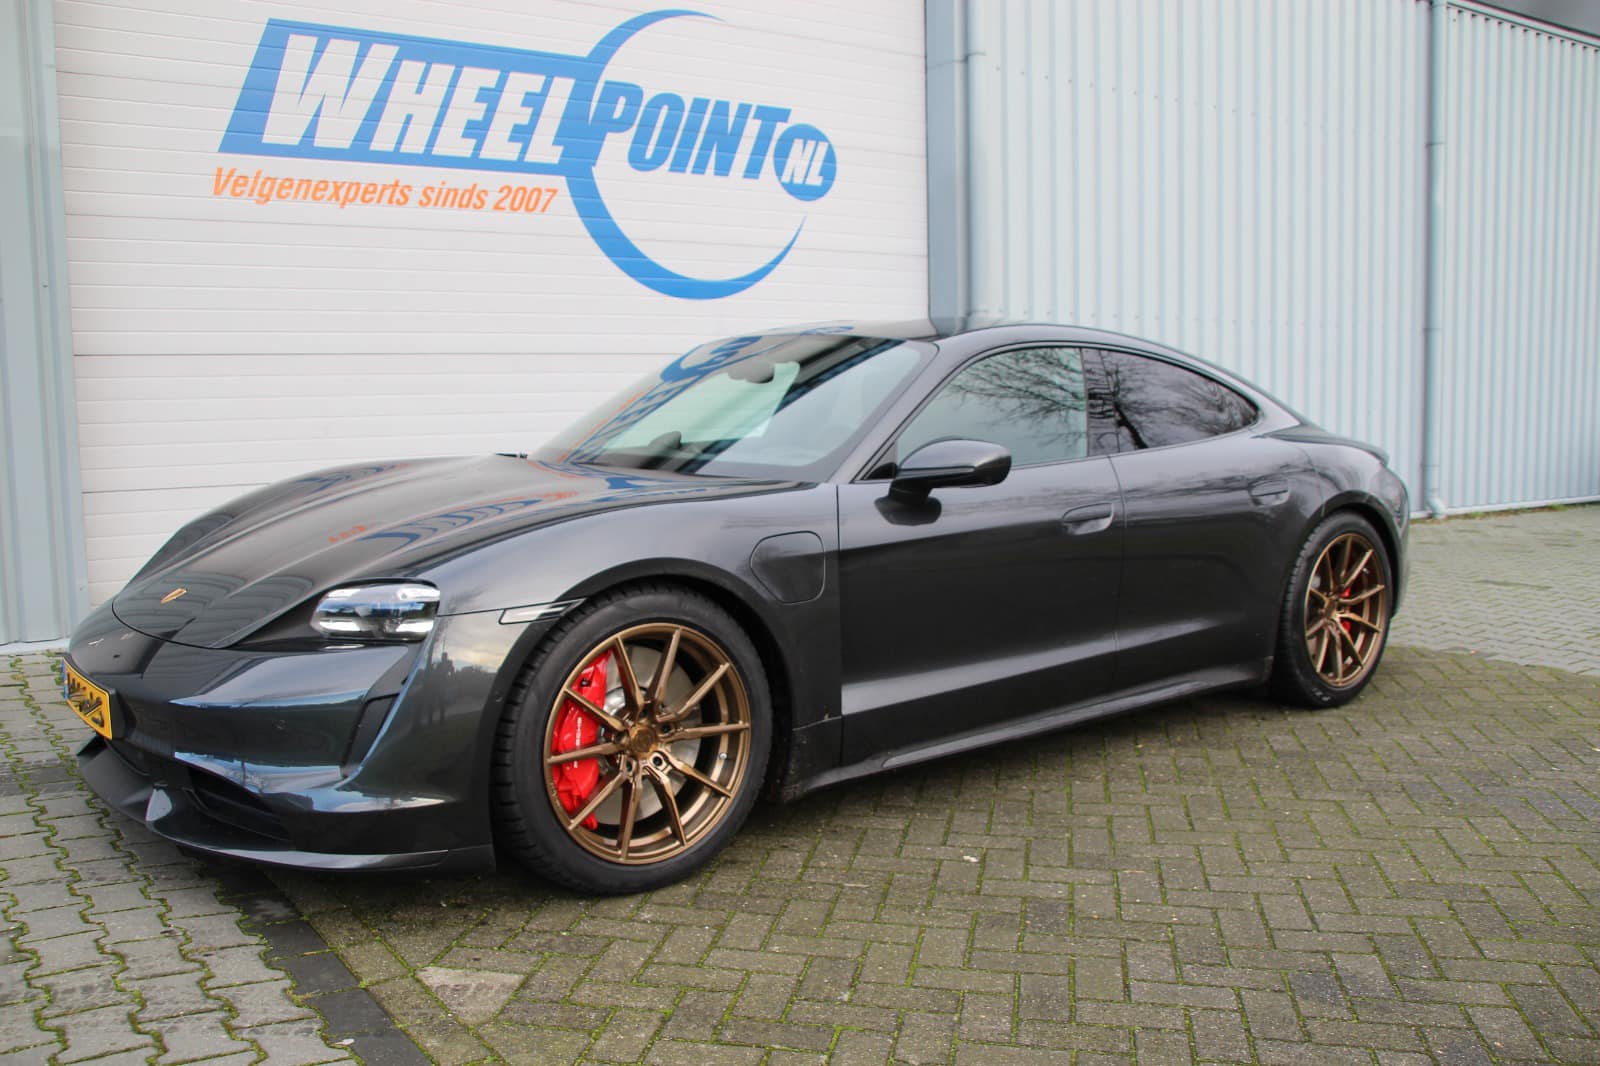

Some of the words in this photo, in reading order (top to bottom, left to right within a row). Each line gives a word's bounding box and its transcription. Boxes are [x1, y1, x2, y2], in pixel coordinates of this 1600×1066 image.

[781, 138, 829, 187] NL
[212, 167, 411, 208] Velgenexperts
[419, 180, 489, 210] sinds
[493, 184, 558, 213] 2007
